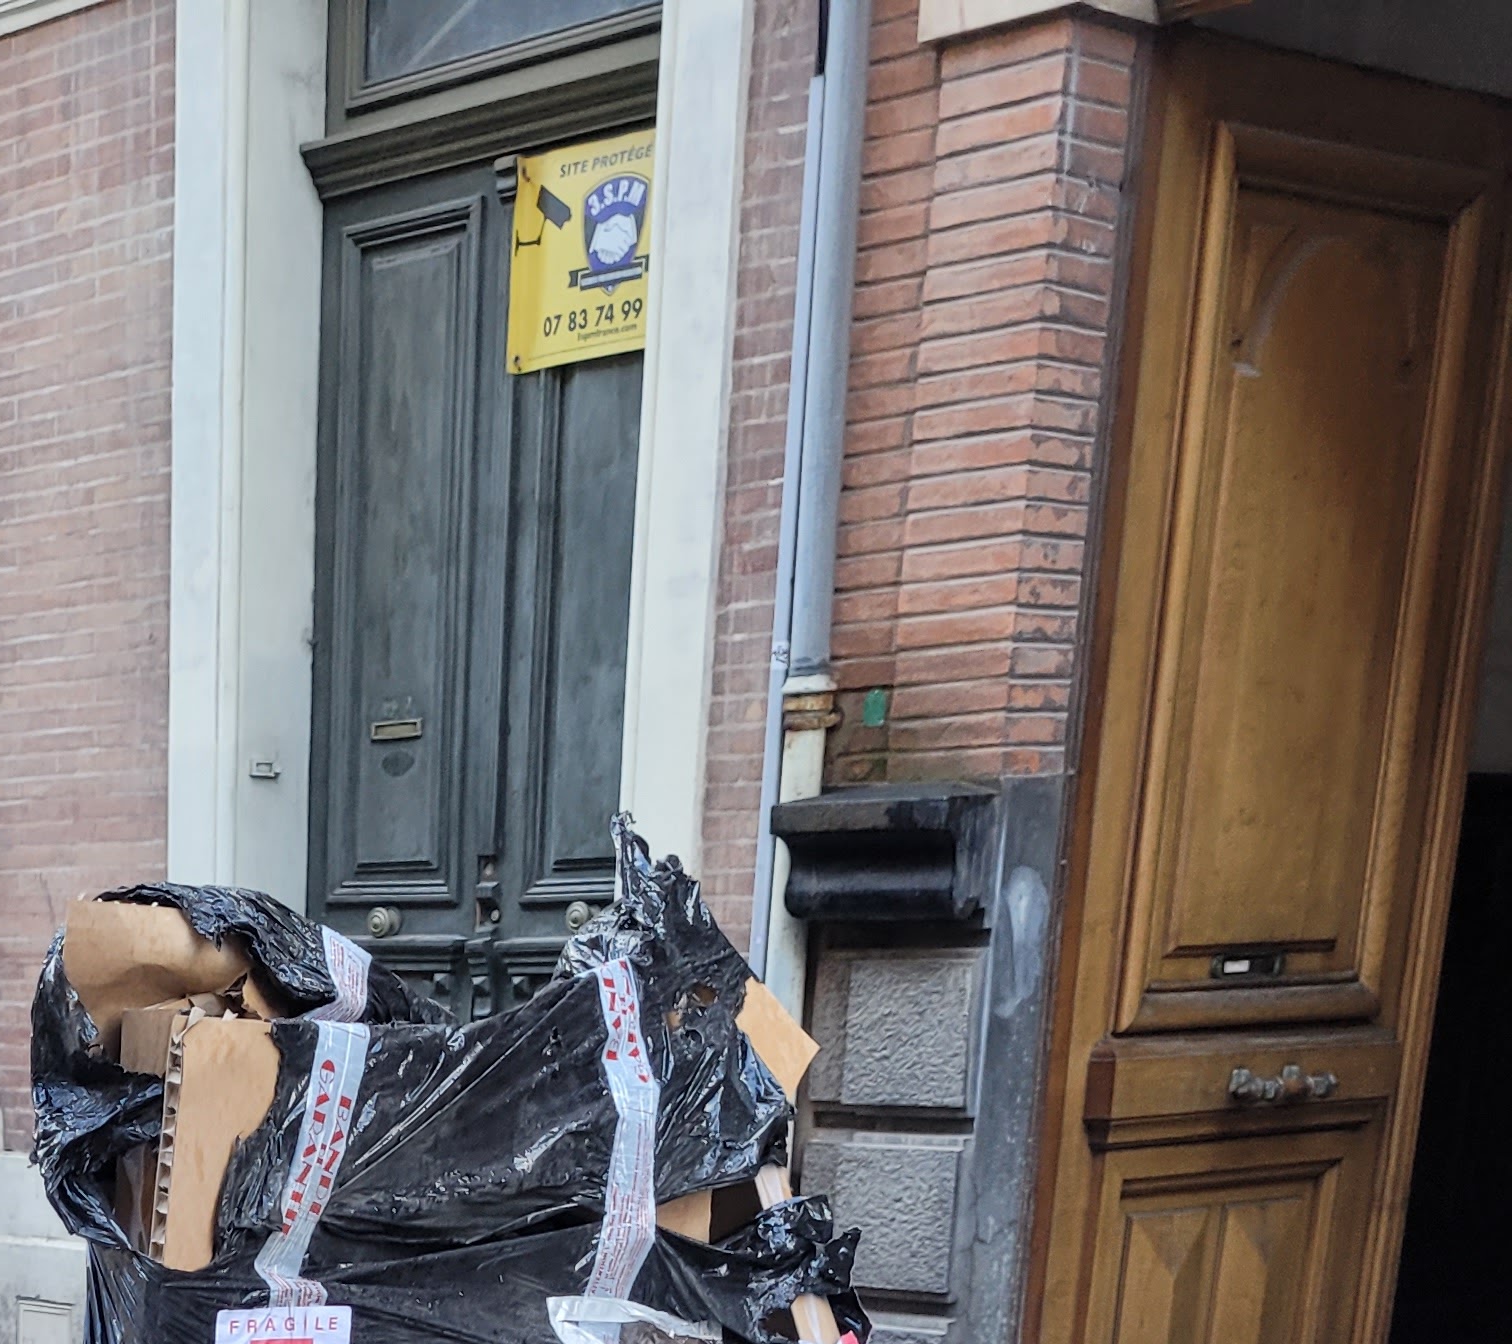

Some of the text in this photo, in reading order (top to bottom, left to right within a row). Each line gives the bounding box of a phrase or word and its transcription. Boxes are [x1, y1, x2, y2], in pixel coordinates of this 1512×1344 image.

[559, 159, 589, 178] SITE
[543, 298, 643, 337] 07 83 74 99
[229, 1316, 338, 1334] FRAGILE
